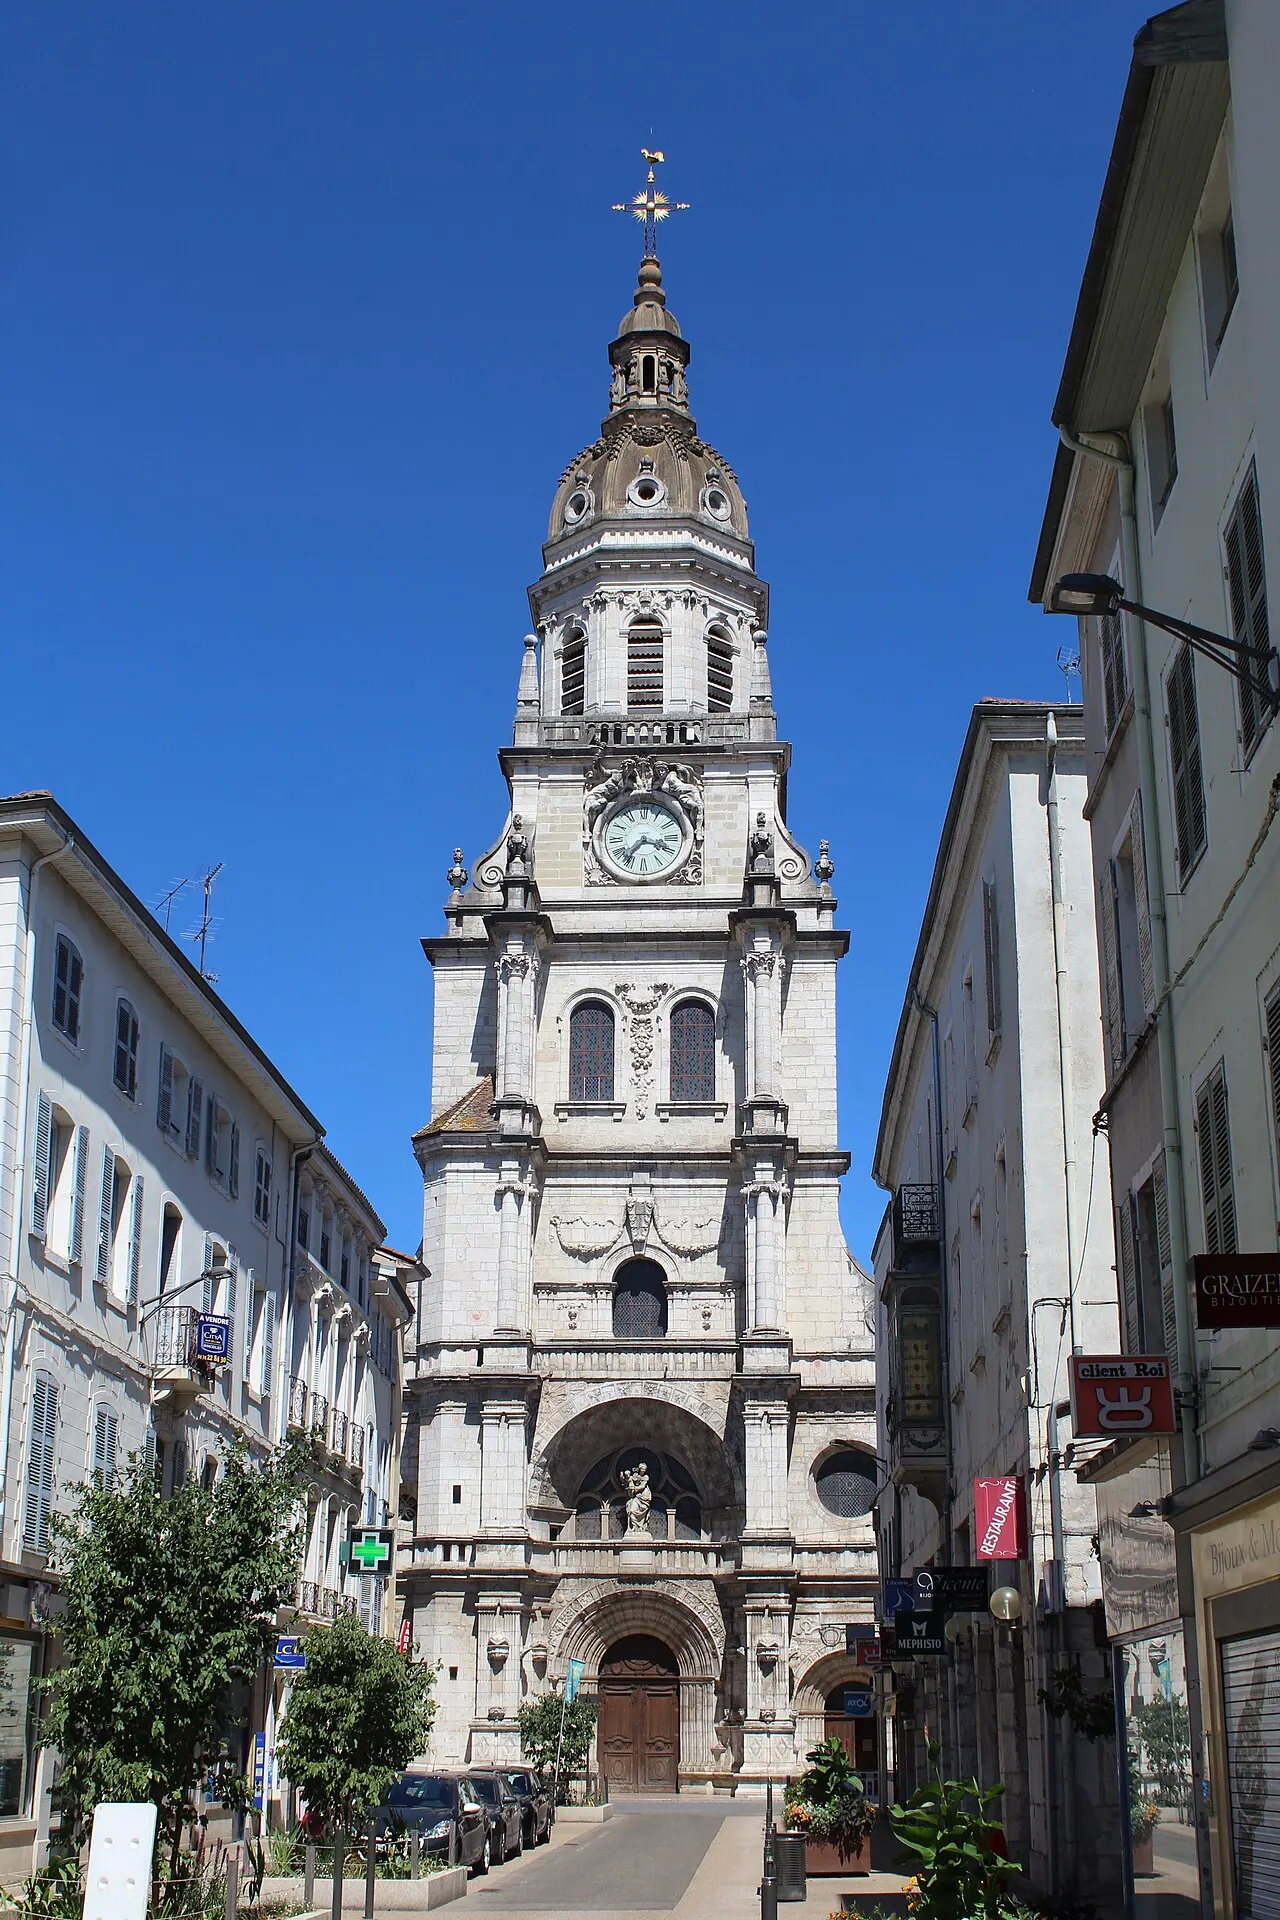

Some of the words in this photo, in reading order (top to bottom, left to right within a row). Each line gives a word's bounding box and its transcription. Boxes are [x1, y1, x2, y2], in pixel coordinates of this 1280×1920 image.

[205, 1316, 229, 1325] VENDRE
[1081, 1363, 1127, 1377] client
[1134, 1362, 1164, 1377] Roi
[980, 1480, 1018, 1555] RESTAURANT
[1210, 1540, 1246, 1584] Bijoux
[1248, 1528, 1259, 1563] &
[898, 1638, 942, 1649] MEPHISTO
